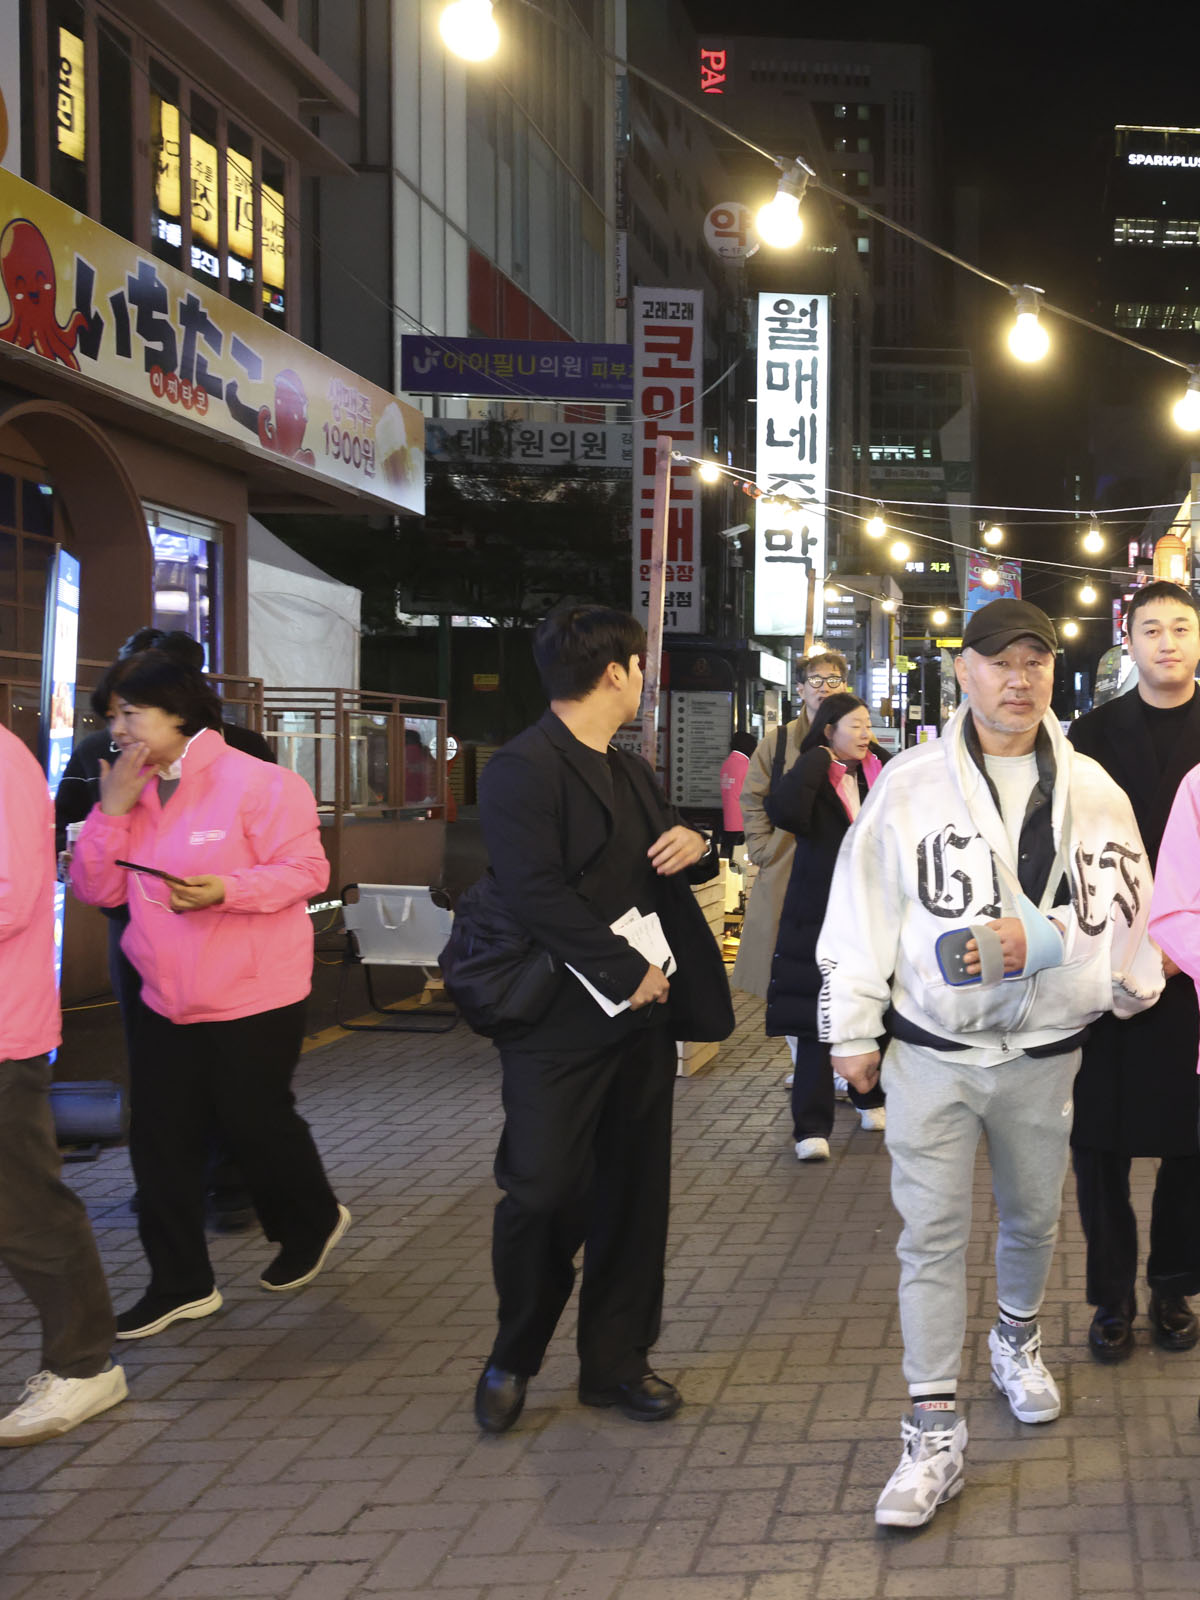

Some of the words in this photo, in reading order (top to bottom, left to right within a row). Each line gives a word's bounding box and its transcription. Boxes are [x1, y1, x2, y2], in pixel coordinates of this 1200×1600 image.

[700, 47, 727, 94] PA
[642, 300, 694, 320] 고래고래
[74, 252, 266, 437] いちたこ
[327, 377, 374, 431] 생맥주
[322, 420, 376, 480] 1900원
[764, 297, 819, 578] 월매네주막
